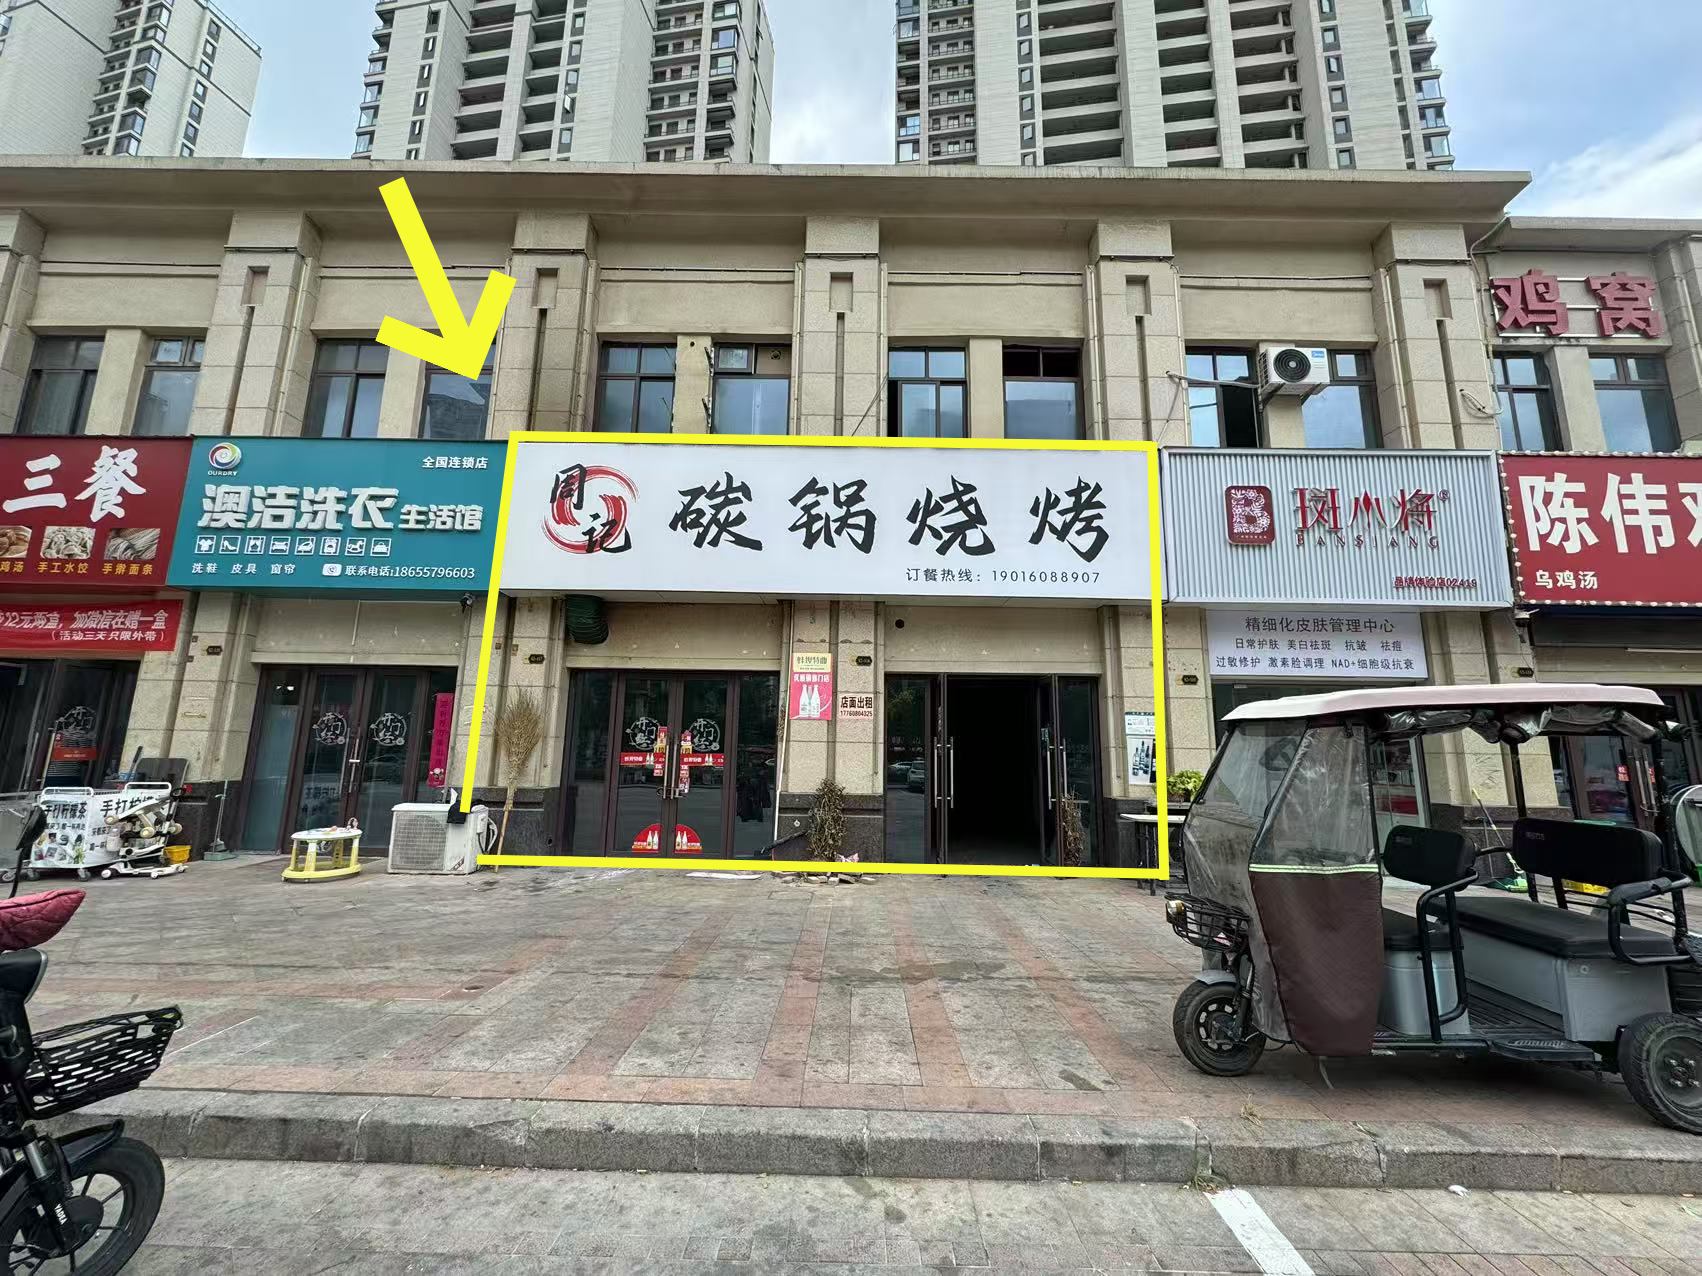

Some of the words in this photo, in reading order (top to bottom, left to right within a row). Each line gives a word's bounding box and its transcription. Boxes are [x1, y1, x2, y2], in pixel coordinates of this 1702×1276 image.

[1489, 268, 1665, 338] 鸡窝
[421, 455, 488, 470] 全国连锁店
[2, 445, 147, 523] 三餐
[197, 484, 400, 531] 澳洁洗衣
[399, 504, 484, 532] 生活馆
[550, 463, 632, 554] 周记
[668, 472, 1111, 562] 碳锅烧烤
[1296, 533, 1440, 549] BANSIANG
[37, 562, 89, 574] 手工水饺
[102, 563, 154, 576] 手擀面条
[192, 563, 218, 575] 洗鞋
[230, 564, 258, 575] 皮具
[270, 564, 296, 575] 窗帘
[1535, 569, 1599, 590] 乌鸡汤
[1245, 616, 1395, 633] 精细化皮肤管理中心
[1235, 638, 1280, 650] 日常护肤
[1287, 639, 1331, 651] 美白祛斑
[1345, 640, 1367, 651] 抗皱
[1380, 640, 1402, 652] 祛痘
[1216, 656, 1261, 668] 过敏修护
[1268, 657, 1325, 669] 激素脸调理
[840, 696, 873, 709] 店面出租
[54, 1203, 68, 1225] YADEA
